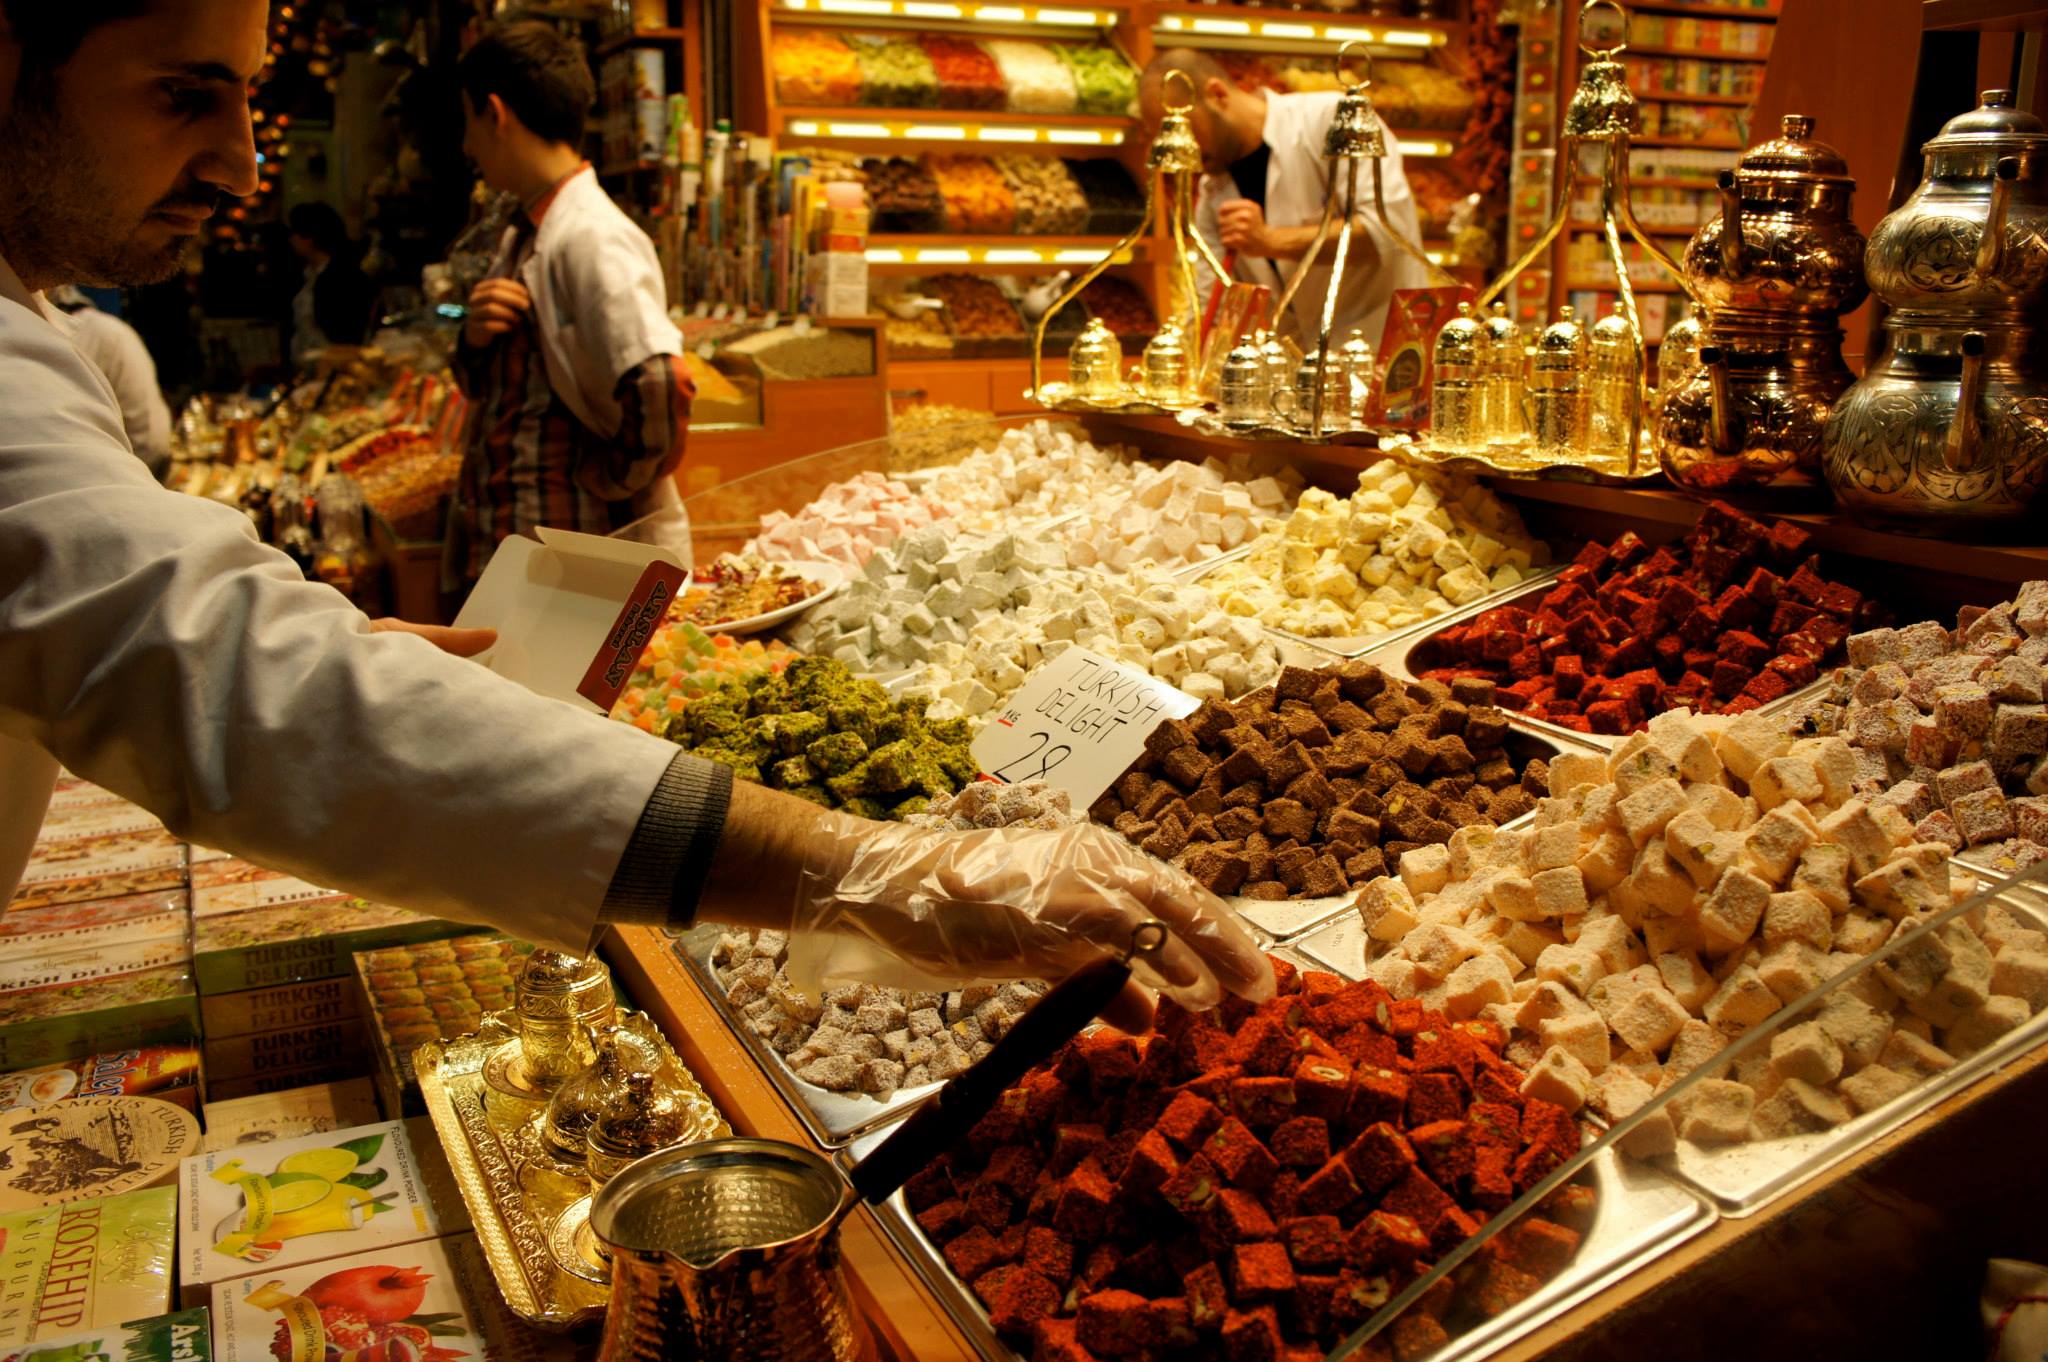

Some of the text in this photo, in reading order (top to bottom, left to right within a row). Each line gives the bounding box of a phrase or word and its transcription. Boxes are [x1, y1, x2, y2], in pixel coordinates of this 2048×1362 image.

[604, 579, 669, 689] ARSLAN
[1068, 658, 1167, 725] TURKISH
[1035, 687, 1128, 743] DELIGHT
[993, 732, 1072, 784] 28
[244, 940, 337, 963] TURKISH
[71, 955, 171, 980] DELIGHT
[245, 959, 337, 985] DELIGHT
[248, 984, 342, 1009] TURKISH
[251, 1002, 342, 1027] DELIGHT
[252, 1025, 342, 1051] TURKISH
[253, 1043, 344, 1070] DELIGHT
[31, 1098, 146, 1114] FAMOUS
[151, 1105, 187, 1154] TURKISH
[403, 1179, 418, 1205] POWDER
[37, 1207, 102, 1328] ROSEHIP
